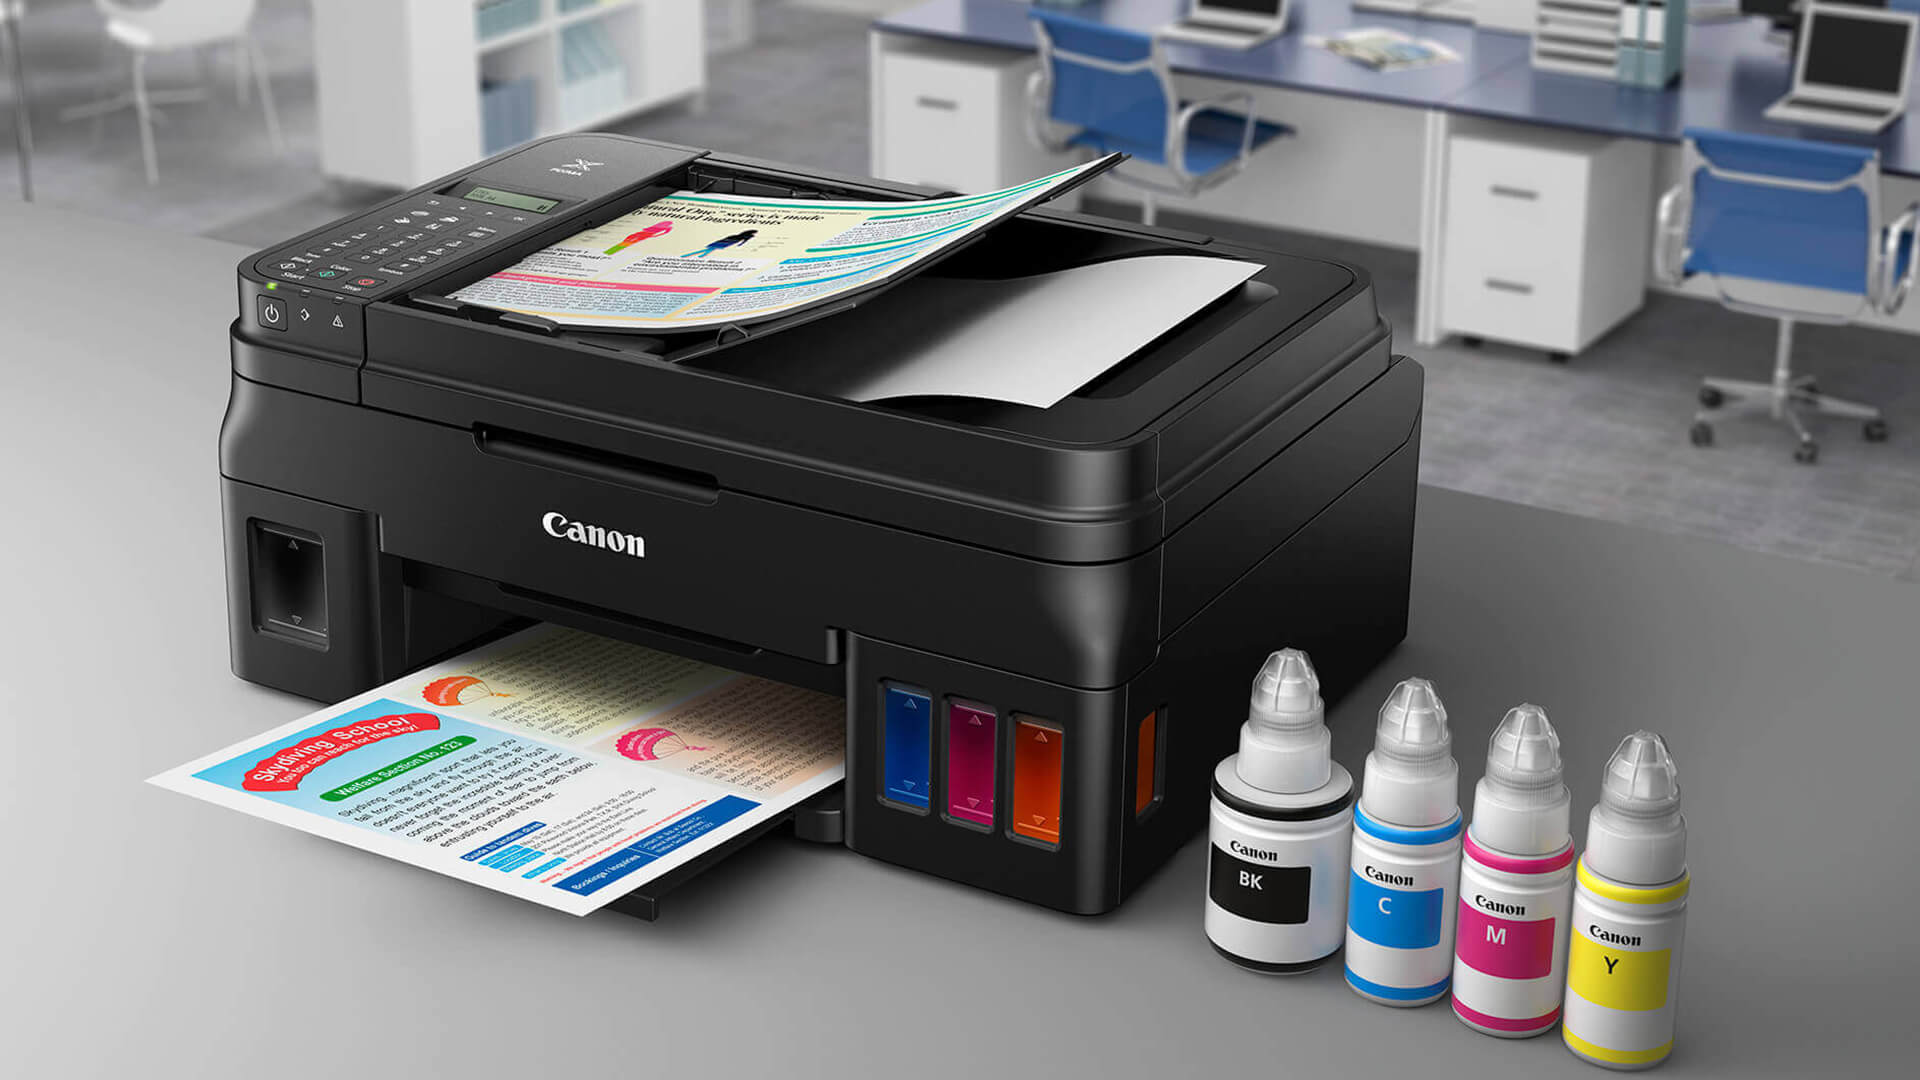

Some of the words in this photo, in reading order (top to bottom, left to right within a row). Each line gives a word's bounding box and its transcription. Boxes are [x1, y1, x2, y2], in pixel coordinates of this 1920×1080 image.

[648, 211, 704, 220] natural
[703, 214, 781, 226] ingredients
[541, 511, 647, 559] Canon
[253, 739, 337, 783] Skydiving
[333, 716, 411, 741] School
[277, 774, 294, 785] You
[293, 762, 309, 776] too
[309, 752, 326, 766] can
[325, 742, 354, 758] reach
[352, 735, 371, 747] for
[370, 729, 391, 741] the
[390, 724, 419, 736] sky!
[335, 774, 382, 797] Welfare
[377, 758, 421, 779] Section
[389, 773, 439, 795] magnificent
[439, 762, 463, 773] sport
[461, 754, 482, 762] that
[498, 739, 516, 747] you
[371, 804, 396, 815] from
[431, 780, 450, 789] and
[462, 760, 496, 774] through
[390, 819, 416, 832] never
[415, 806, 445, 819] forget
[461, 781, 502, 799] incredible
[500, 767, 533, 780] feeling
[407, 821, 443, 837] coming
[440, 813, 458, 821] the
[458, 796, 495, 813] moment
[504, 782, 524, 791] fear
[537, 767, 559, 778] jump
[556, 757, 579, 767] from
[407, 793, 448, 812] everyone
[447, 783, 470, 793] want
[424, 829, 453, 842] above
[470, 807, 500, 820] clouds
[441, 826, 487, 847] entrusting
[484, 809, 518, 827] yourself
[1229, 840, 1278, 862] Canon
[572, 872, 607, 889] Bookings
[608, 855, 640, 870] Inquiries
[1238, 870, 1263, 891] BK
[1365, 865, 1414, 887] Canon
[1378, 897, 1392, 915] C
[1475, 894, 1526, 916] Canon
[1486, 925, 1506, 946] M
[1589, 924, 1642, 947] Canon
[1603, 956, 1621, 975] Y
